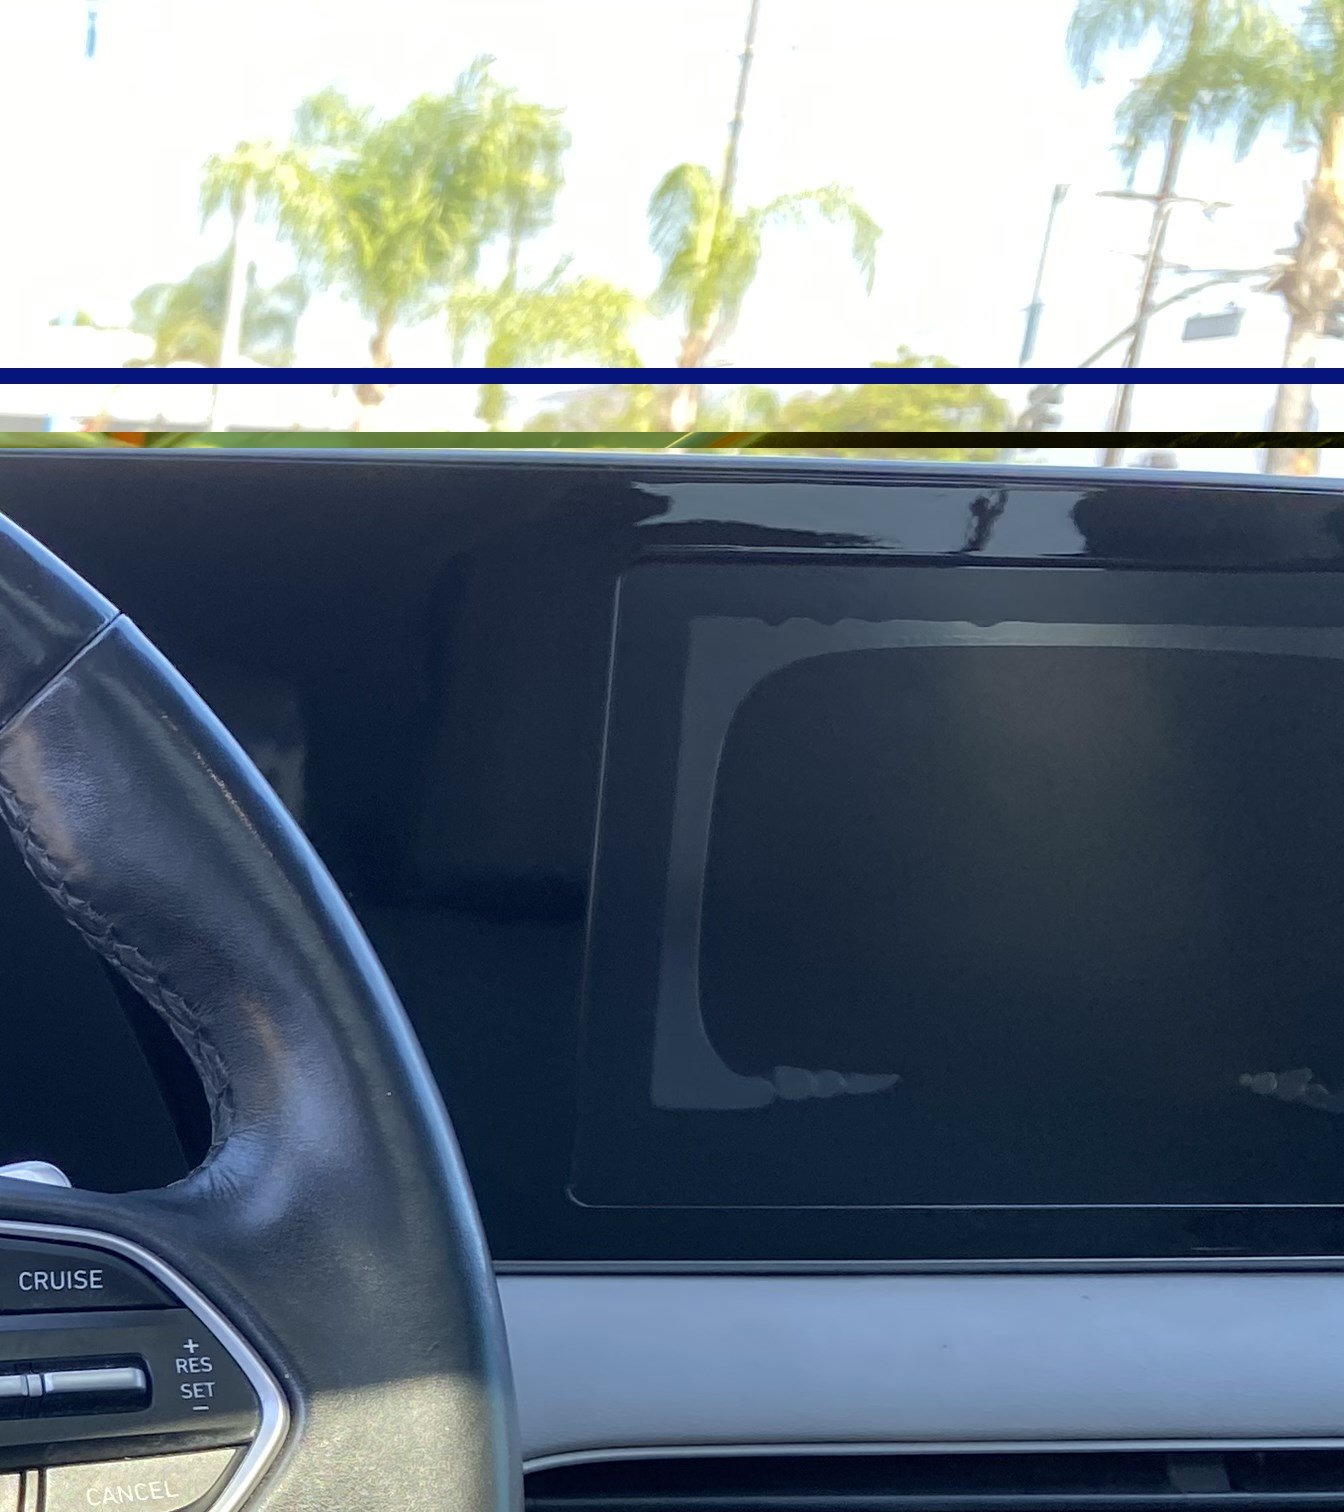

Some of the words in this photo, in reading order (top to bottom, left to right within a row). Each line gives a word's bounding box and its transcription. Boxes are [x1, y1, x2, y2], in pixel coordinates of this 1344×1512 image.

[19, 1270, 103, 1292] CRUISE
[175, 1356, 213, 1374] RES
[181, 1382, 215, 1400] SET
[86, 1480, 179, 1506] CANCEL
